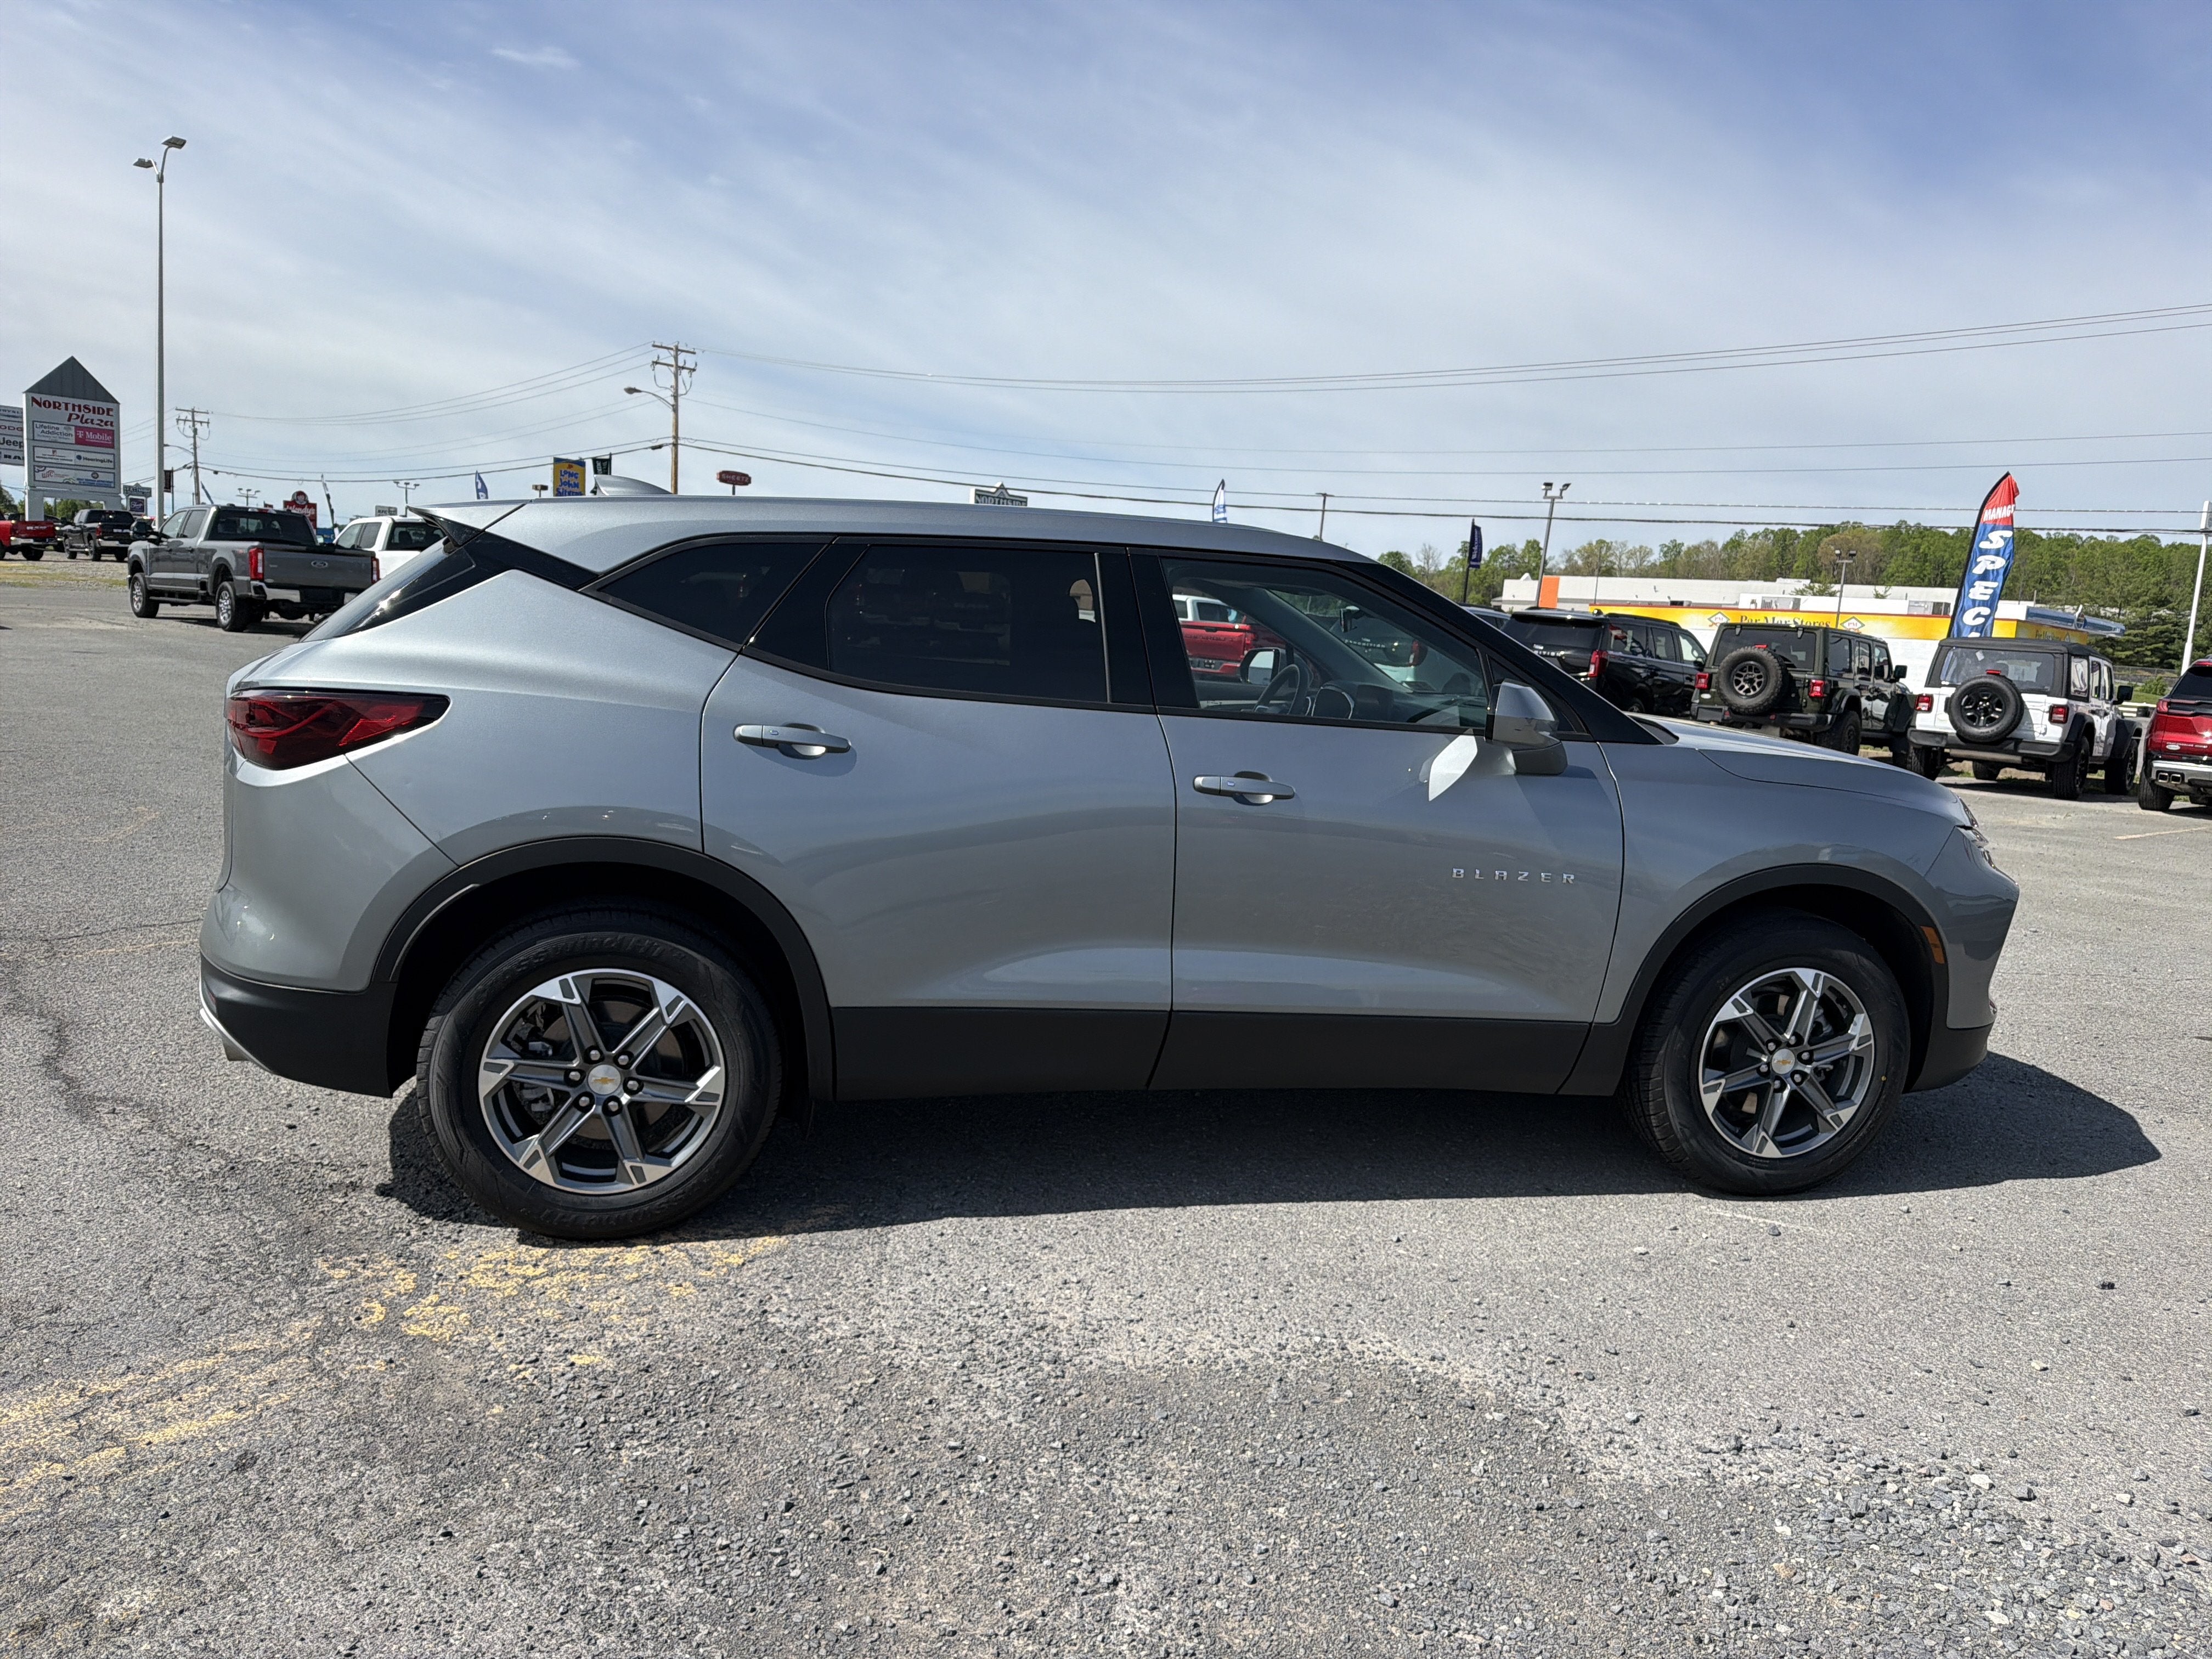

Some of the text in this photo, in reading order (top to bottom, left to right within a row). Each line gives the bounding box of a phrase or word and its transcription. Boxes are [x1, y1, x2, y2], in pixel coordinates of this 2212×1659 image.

[31, 396, 114, 417] NORTHSIDE
[67, 413, 115, 427] Plaza
[40, 429, 73, 437] Addiction
[86, 431, 112, 441] Mobile
[1792, 617, 1831, 628] Stores
[1452, 867, 1575, 884] BLAZER
